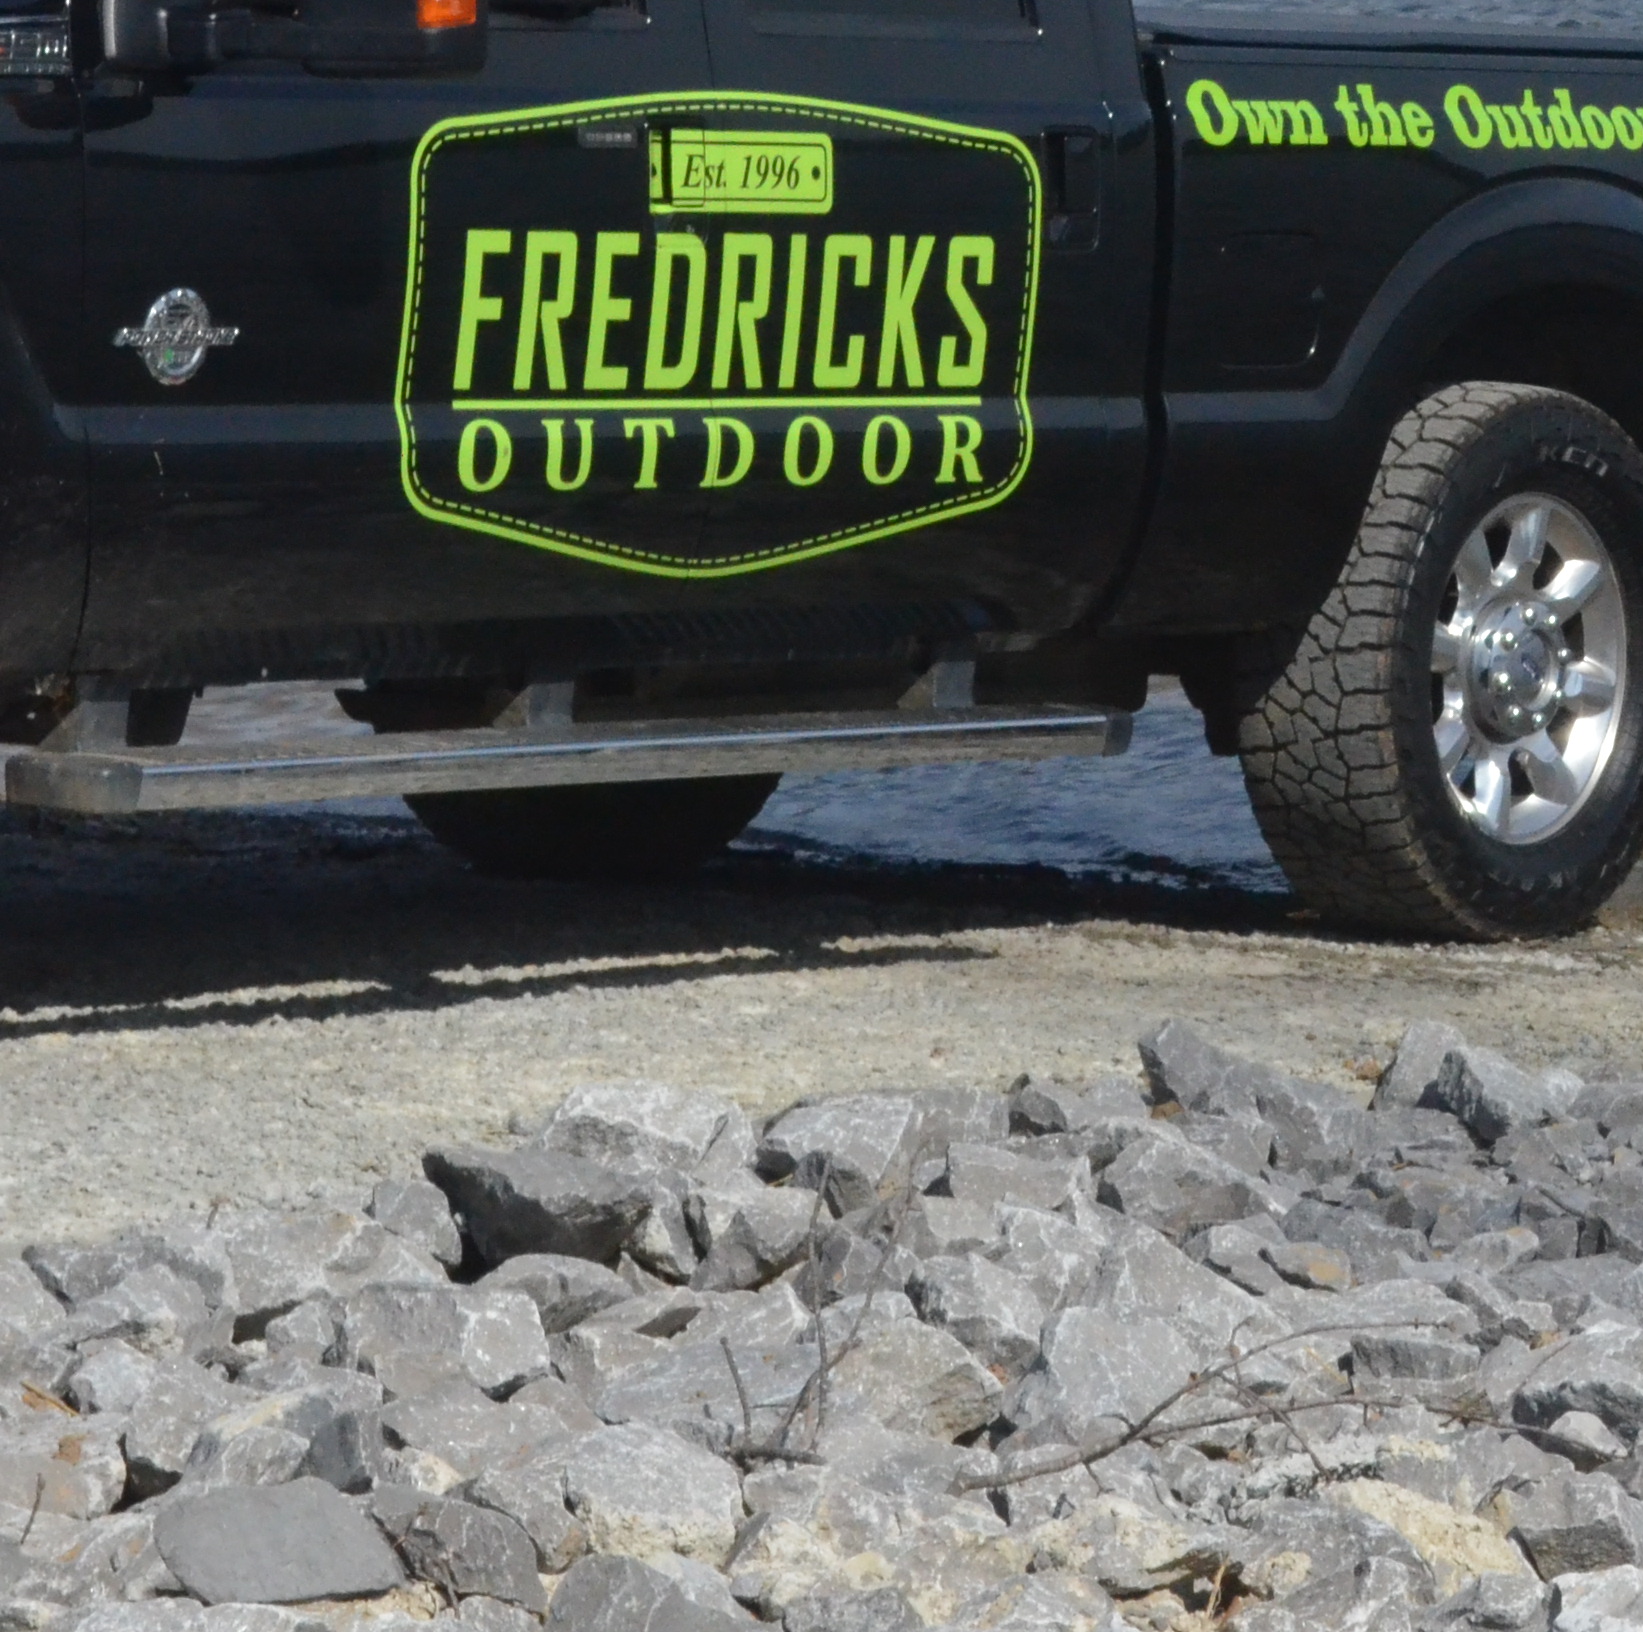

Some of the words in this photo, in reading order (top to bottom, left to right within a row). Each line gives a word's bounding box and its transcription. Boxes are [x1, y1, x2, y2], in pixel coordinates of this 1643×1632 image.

[1186, 78, 1328, 147] Own
[1335, 83, 1436, 149] the
[681, 154, 728, 189] Est.
[740, 154, 801, 190] 1996
[453, 229, 995, 391] FREDRICKS
[457, 415, 983, 492] OUTDOOR
